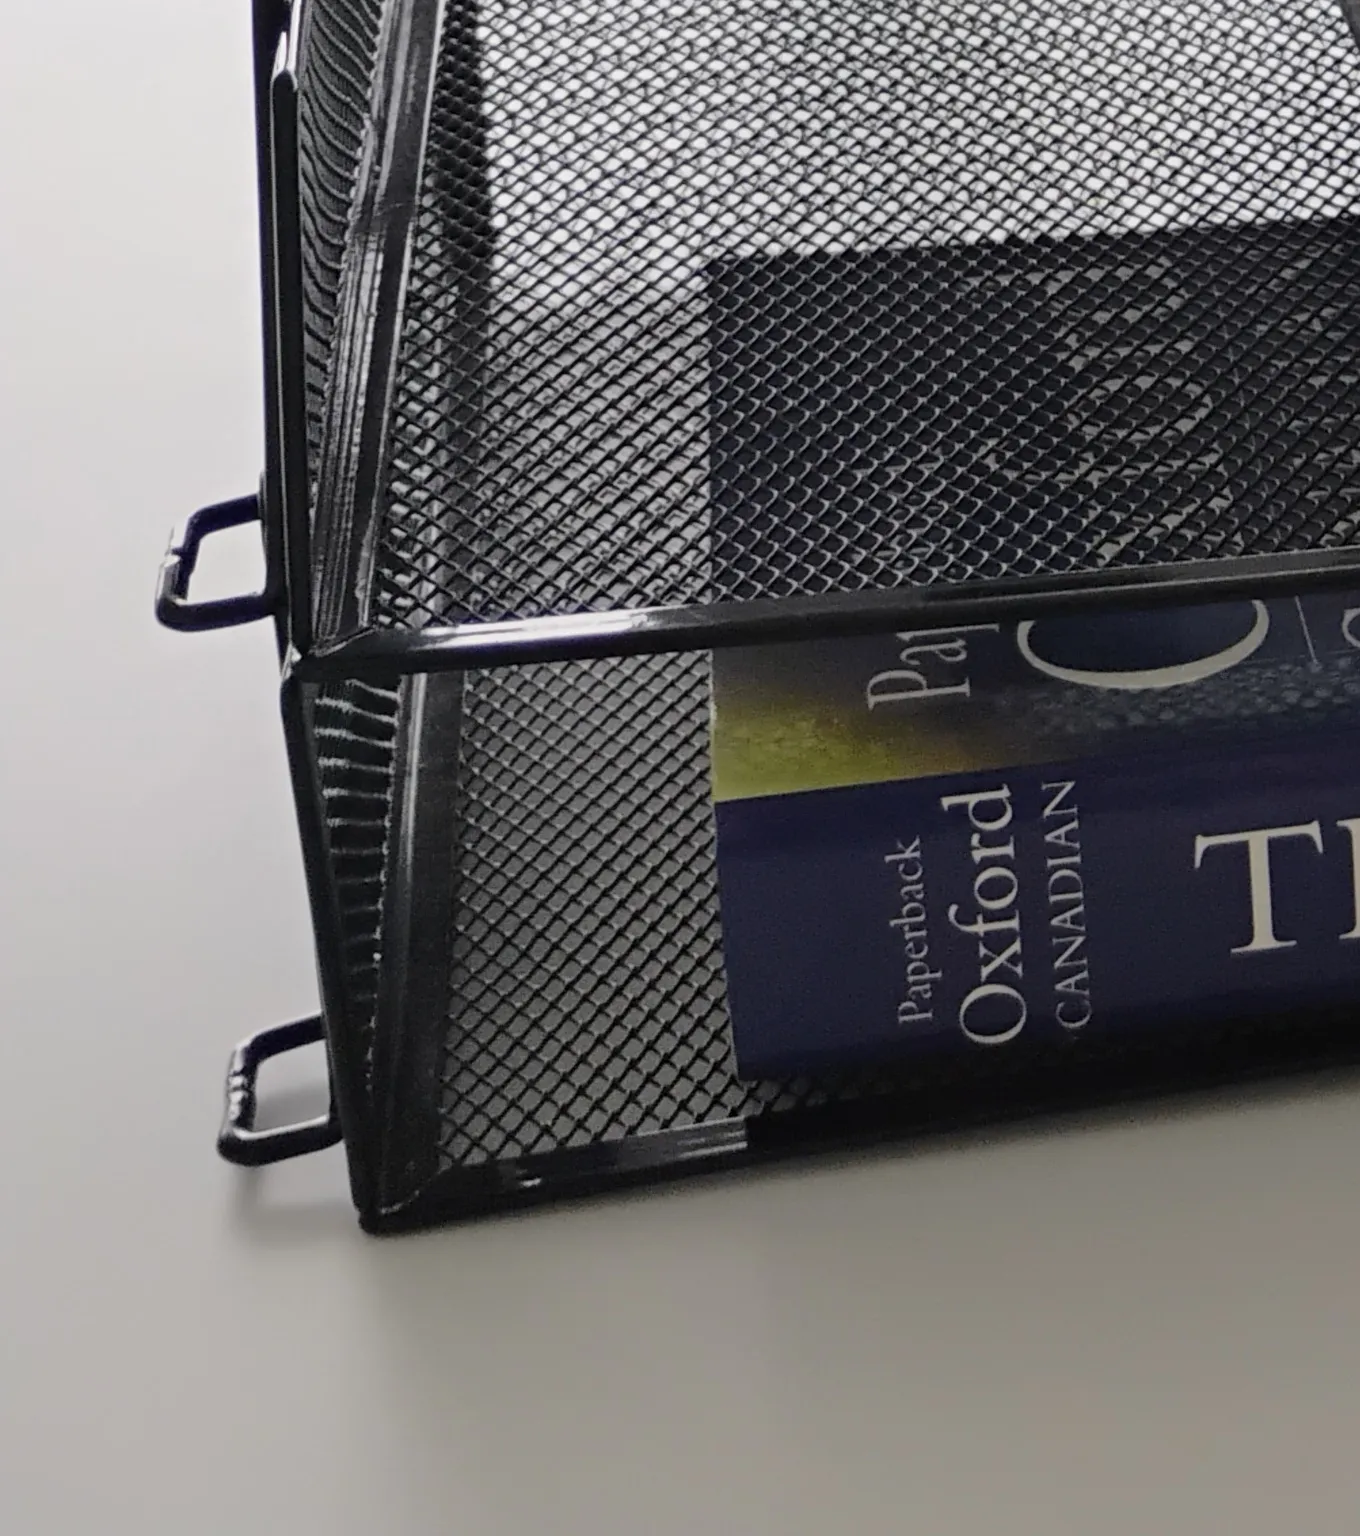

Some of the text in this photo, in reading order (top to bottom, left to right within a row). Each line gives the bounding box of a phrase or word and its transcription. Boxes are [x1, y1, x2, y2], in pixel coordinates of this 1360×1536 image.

[883, 834, 944, 1026] Paperback
[939, 782, 1029, 1046] Oxford
[1040, 779, 1093, 1031] CANADIAN
